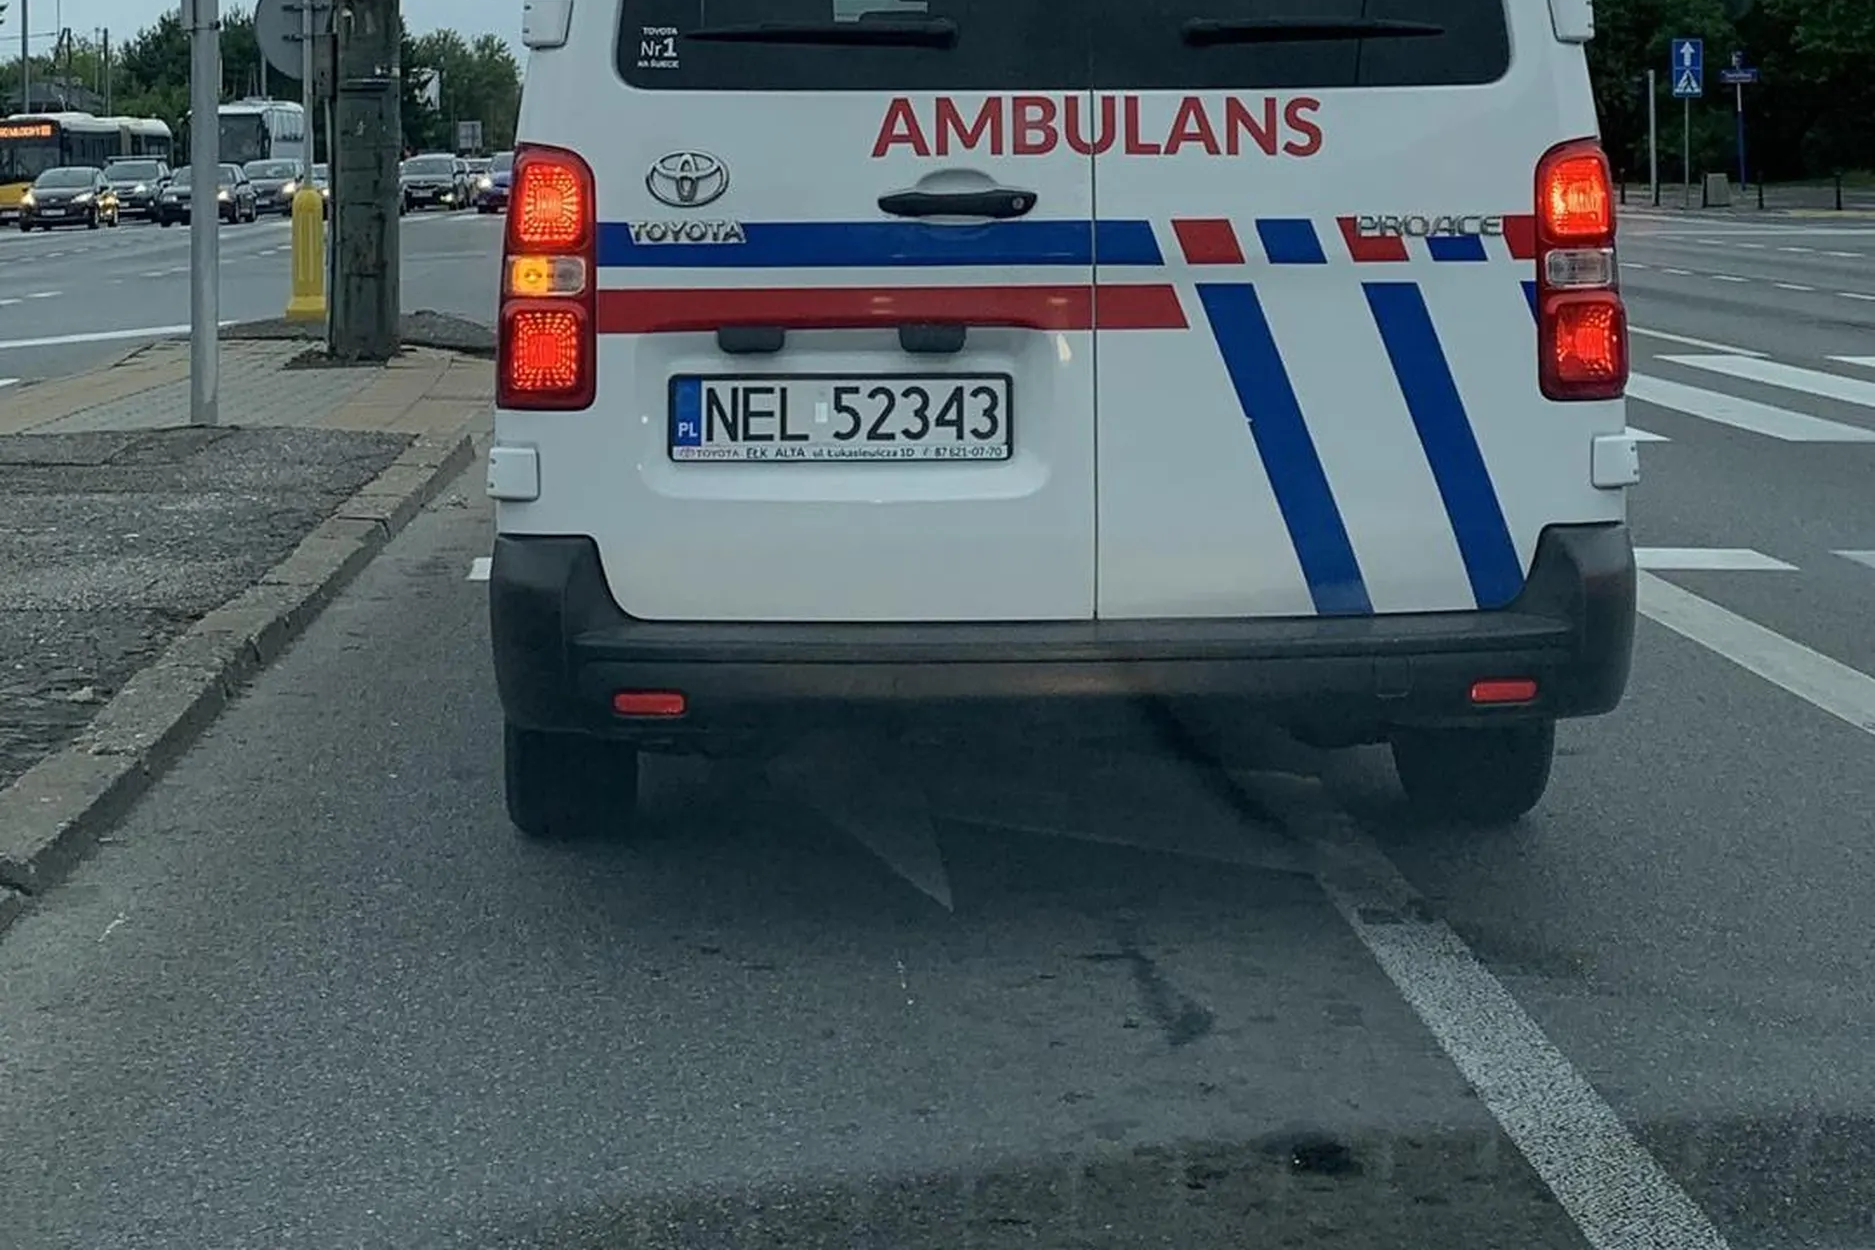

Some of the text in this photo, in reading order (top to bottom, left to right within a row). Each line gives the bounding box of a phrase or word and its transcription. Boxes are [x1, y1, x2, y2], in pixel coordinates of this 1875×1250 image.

[642, 26, 678, 36] TOYOTA
[871, 95, 1323, 158] AMBULANS
[629, 220, 746, 242] TOYOTA
[1356, 214, 1504, 237] PROACE
[706, 386, 999, 442] NEL 52343
[678, 422, 698, 437] PL
[696, 449, 739, 458] TOYOTA
[775, 447, 805, 457] ALTA
